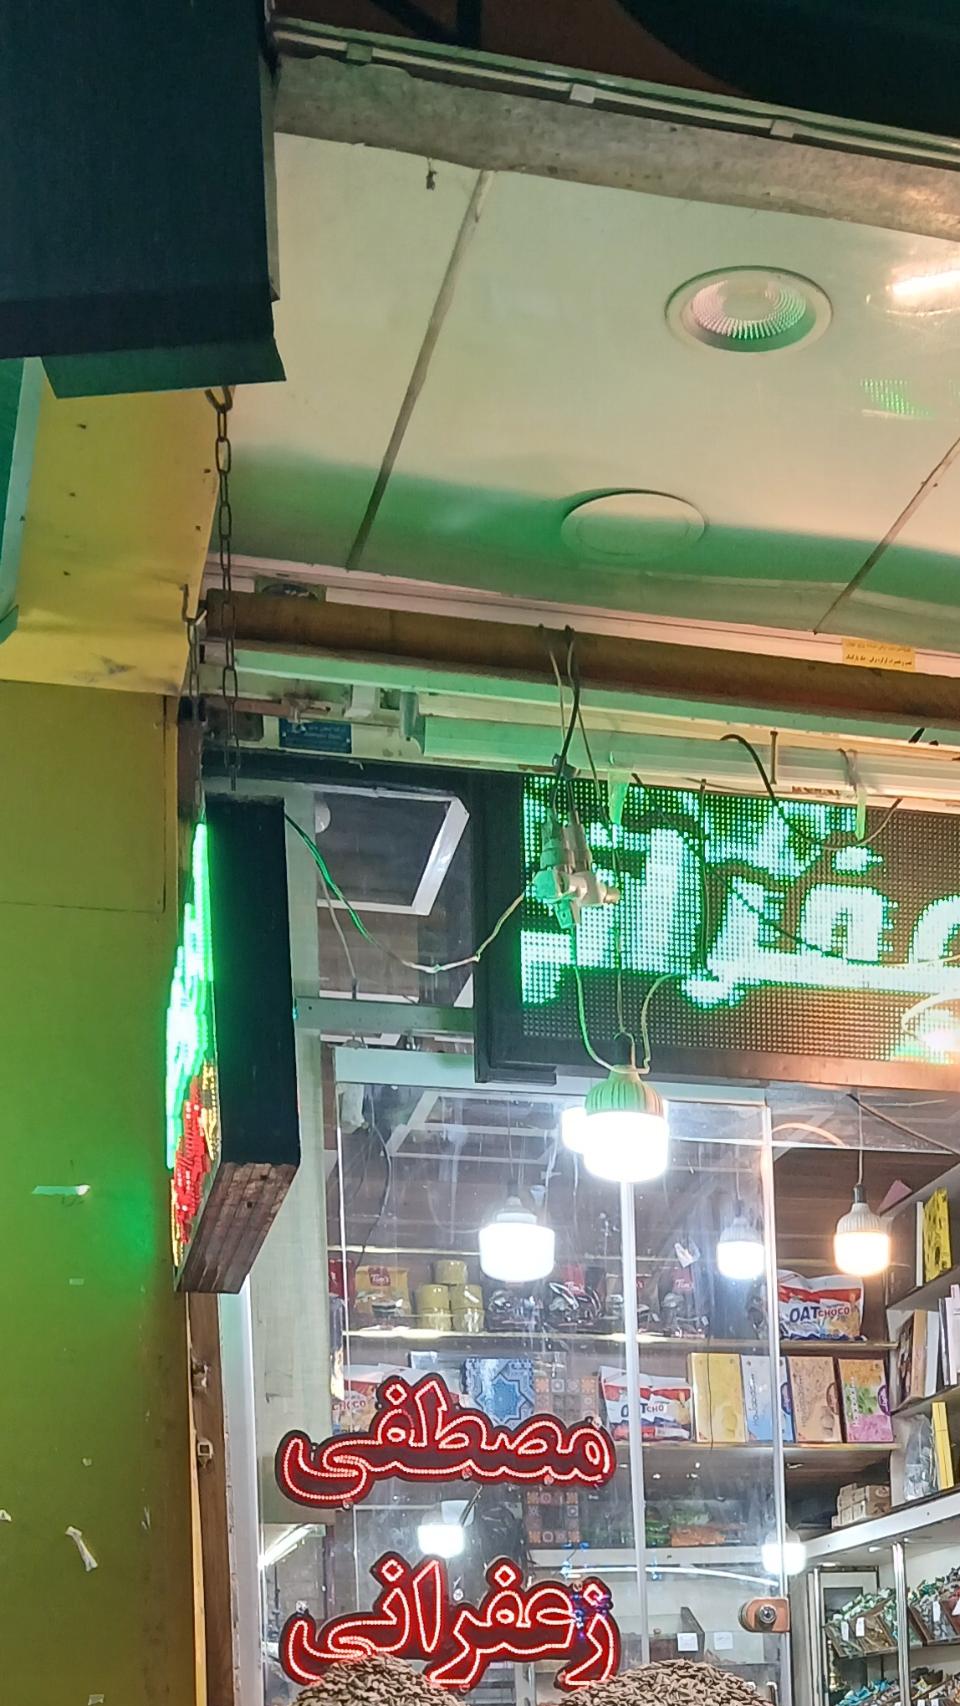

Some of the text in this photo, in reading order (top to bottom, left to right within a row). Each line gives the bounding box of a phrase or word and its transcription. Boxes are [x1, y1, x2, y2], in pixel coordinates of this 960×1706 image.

[789, 1306, 821, 1323] OAT
[281, 1379, 613, 1502] مصطفی
[285, 1558, 616, 1686] زعفرانی
